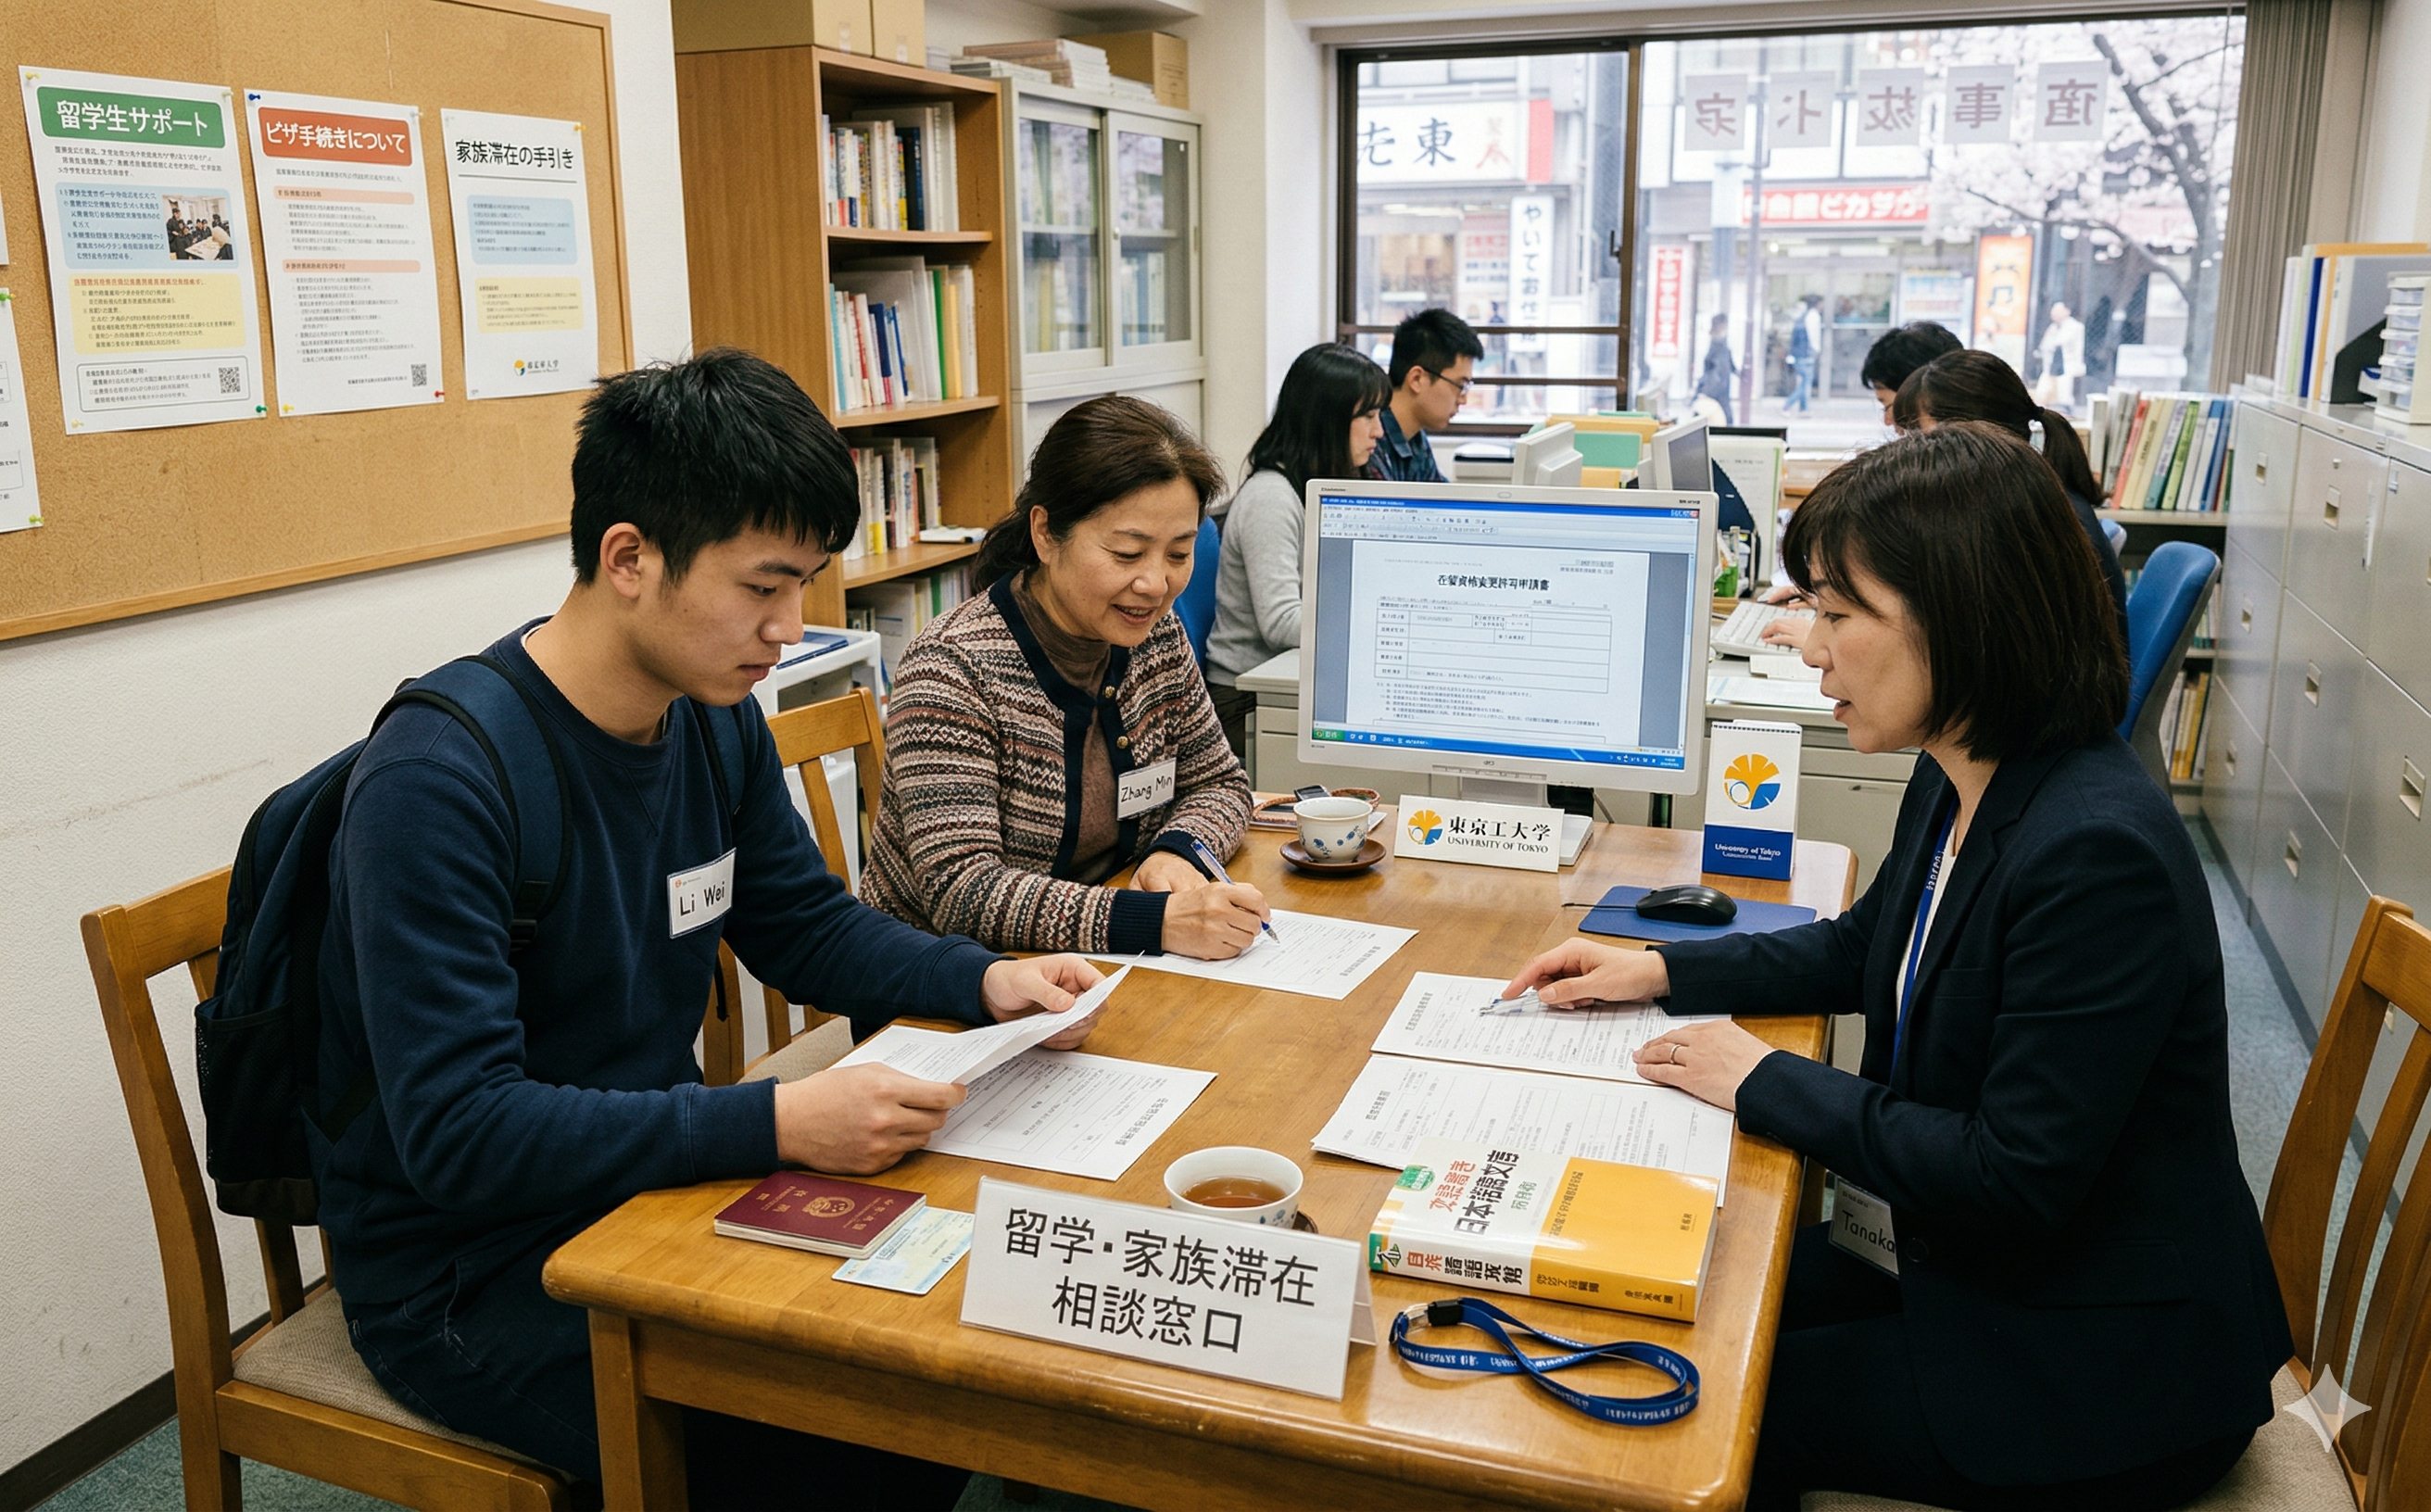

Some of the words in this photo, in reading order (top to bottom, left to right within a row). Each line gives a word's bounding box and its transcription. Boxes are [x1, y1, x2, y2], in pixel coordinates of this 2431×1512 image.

[56, 99, 208, 137] 留学生サポート
[266, 121, 406, 153] ビザ手続きについて
[455, 140, 574, 170] 家族滞在の手引き
[1121, 786, 1152, 803] Zhang
[1155, 775, 1173, 791] Min
[1449, 815, 1552, 841] 東京工大学
[680, 893, 695, 916] Li
[704, 881, 724, 907] Wei
[1842, 1209, 1896, 1254] Tanaka
[1005, 1207, 1319, 1307] 留学・家族滞在
[1052, 1276, 1243, 1354] 相談窓口
